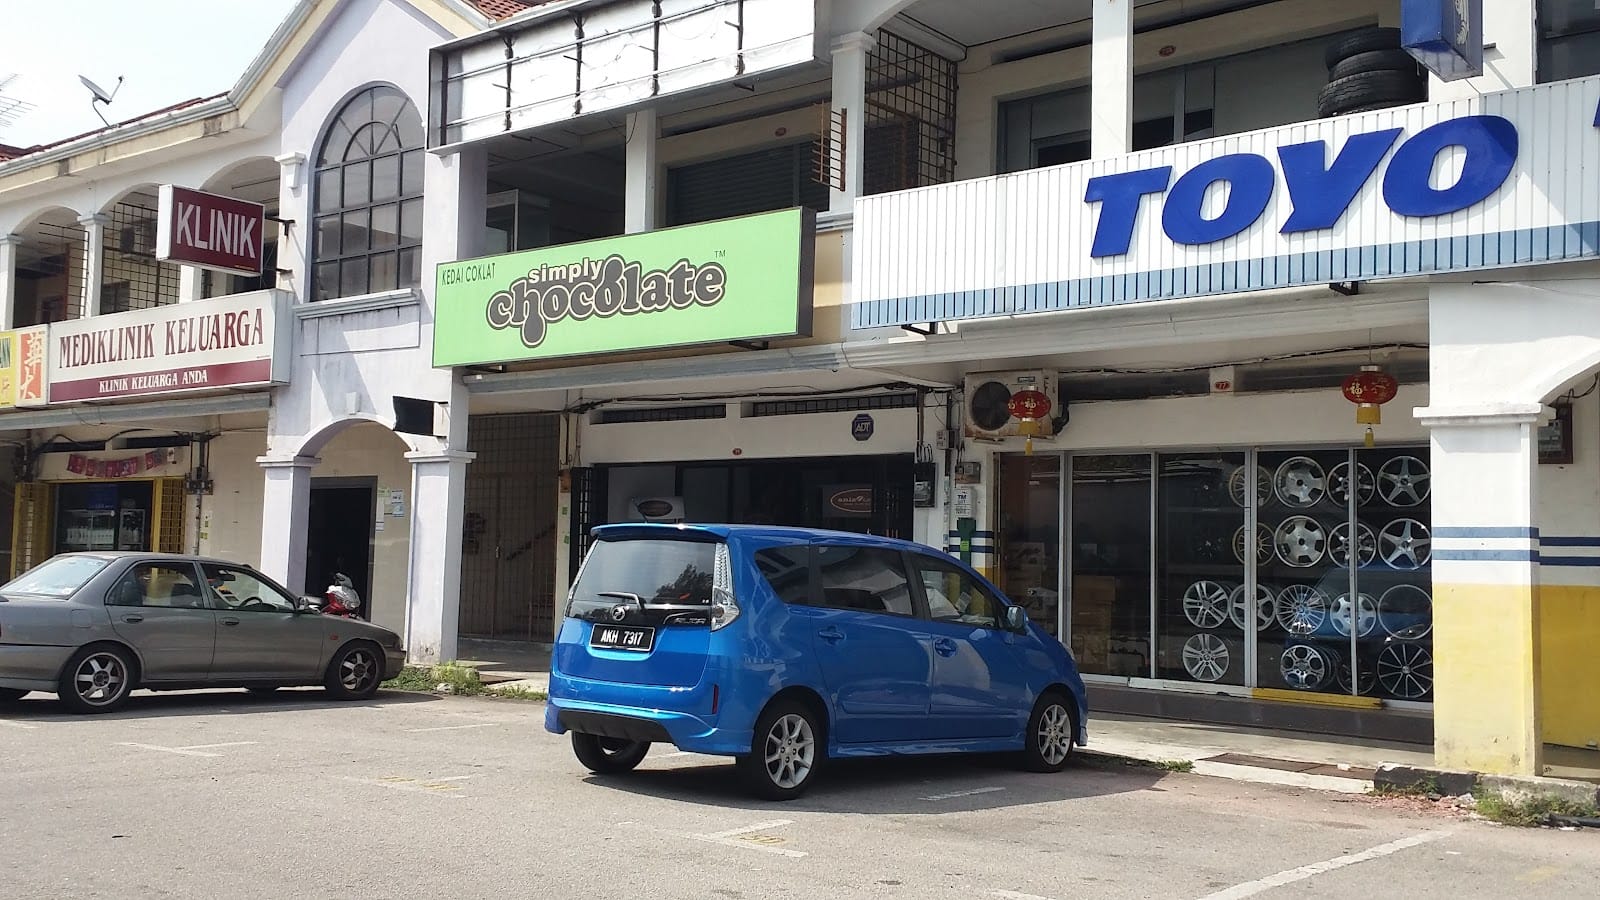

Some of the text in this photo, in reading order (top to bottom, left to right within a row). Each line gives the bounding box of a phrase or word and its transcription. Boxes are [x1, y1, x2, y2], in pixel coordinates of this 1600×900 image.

[1084, 114, 1519, 258] TOYO
[176, 201, 257, 259] KLINIK
[441, 263, 496, 286] KEDAI COKLAT
[528, 256, 604, 285] simply
[486, 253, 727, 348] chocolate
[59, 308, 264, 369] MEDIKLINIK KELUARGA
[99, 370, 209, 393] KLINIK KELUARGA ANDA
[600, 629, 644, 646] AKH 7317
